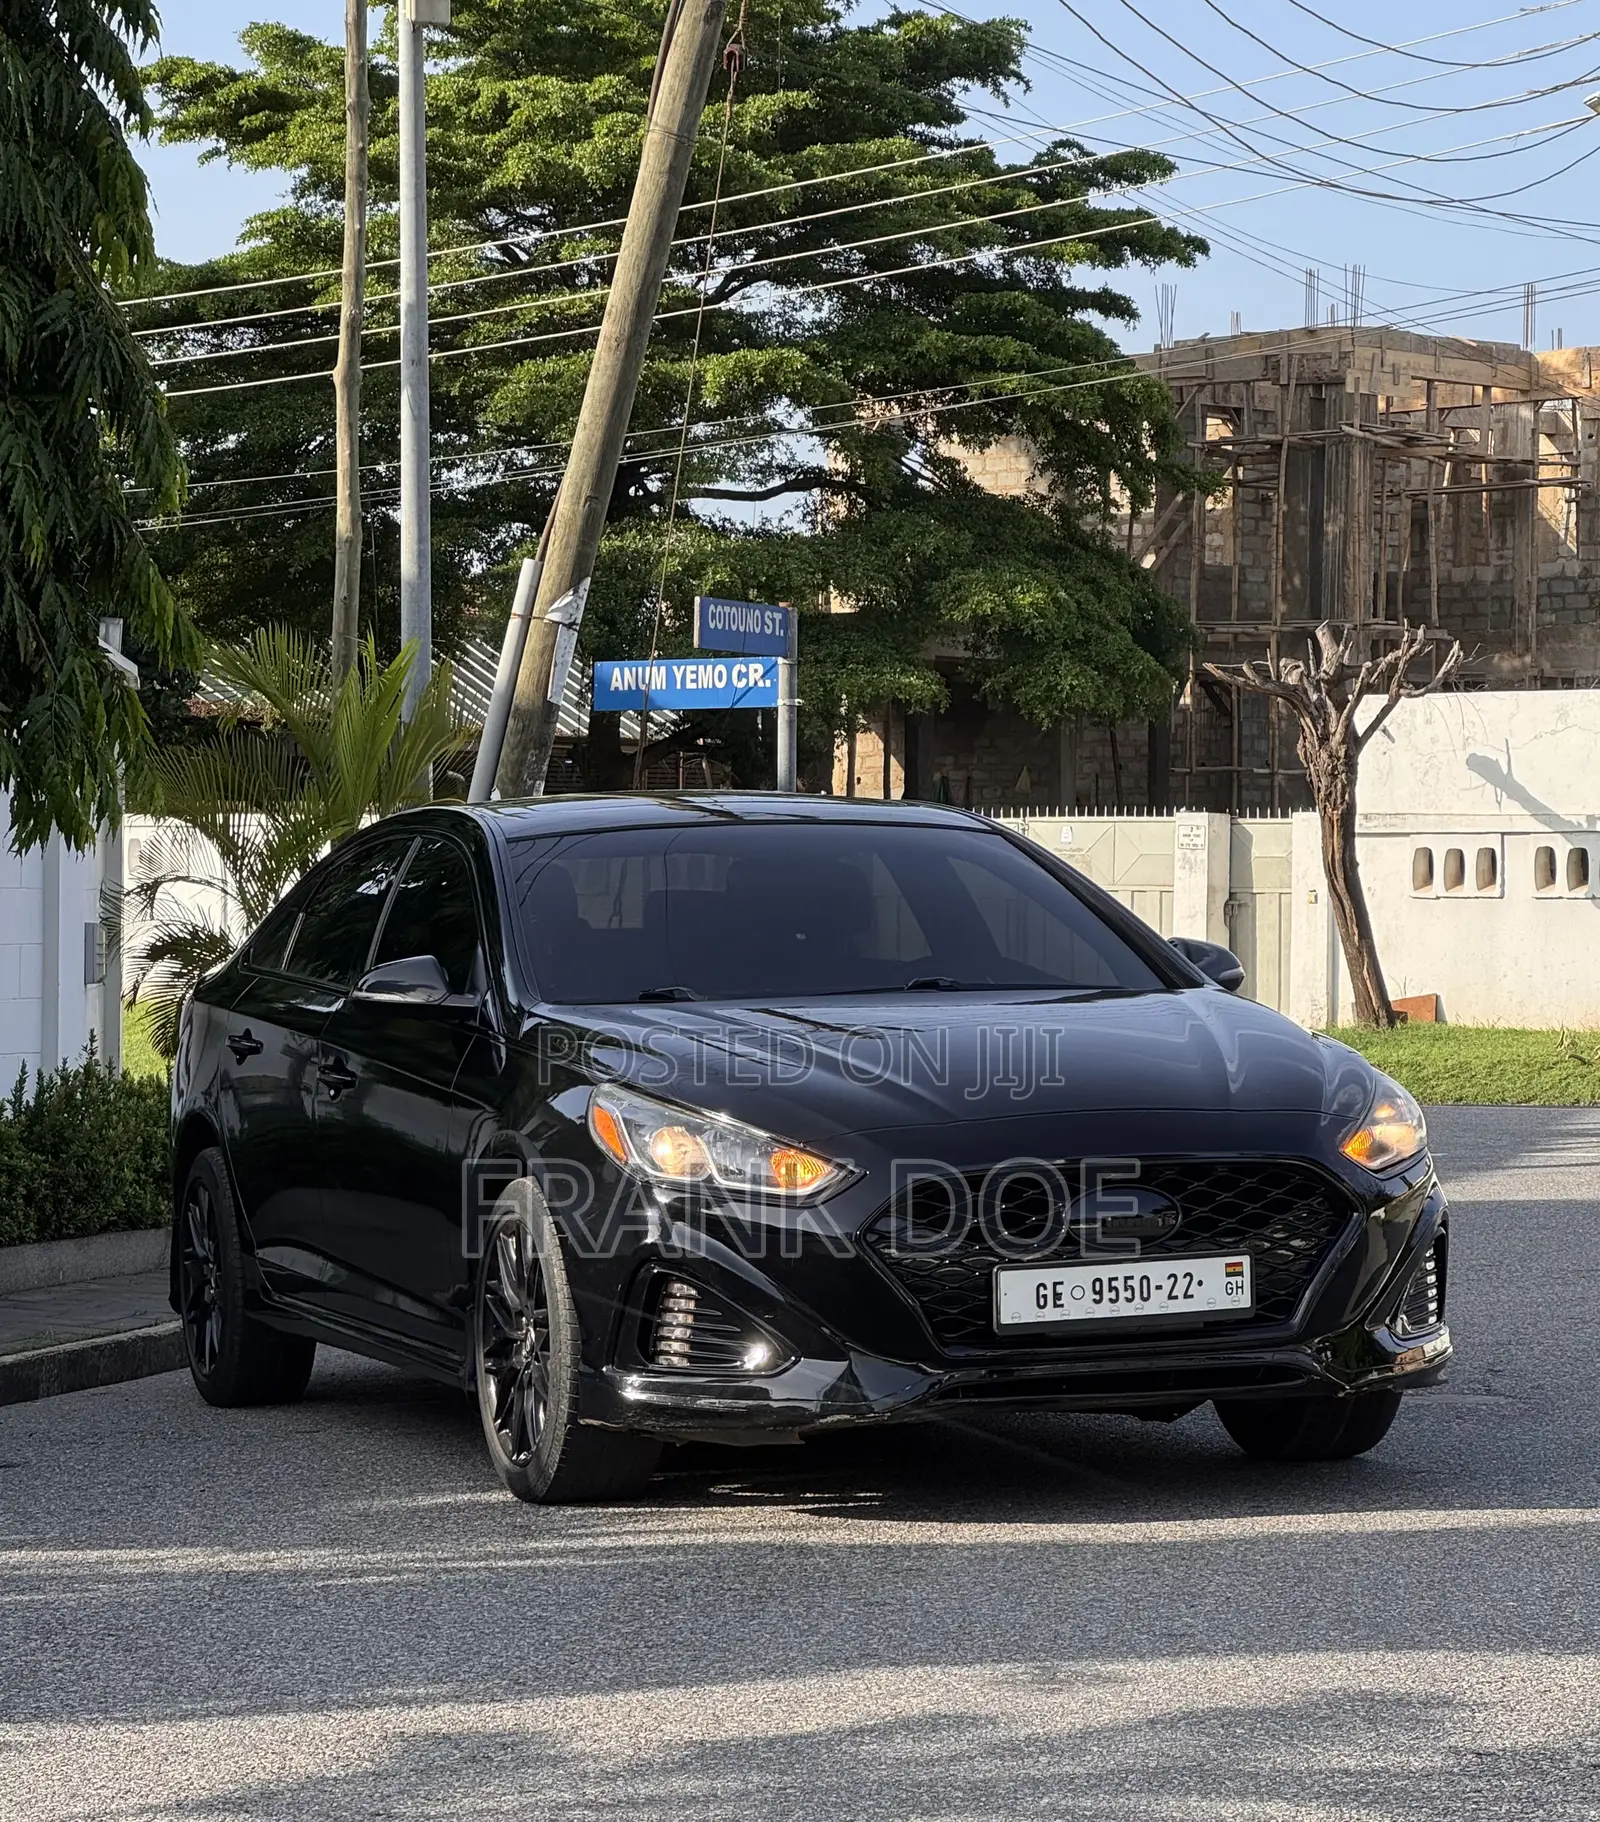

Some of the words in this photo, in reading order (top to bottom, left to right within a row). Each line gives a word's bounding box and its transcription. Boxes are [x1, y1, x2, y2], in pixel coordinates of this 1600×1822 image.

[708, 603, 762, 634] COTOUNO
[764, 610, 785, 637] ST.
[609, 665, 667, 692] ANUM
[672, 663, 727, 689] YEMO
[731, 662, 772, 689] CR.
[1035, 1281, 1065, 1310] GE
[1225, 1279, 1245, 1296] GH
